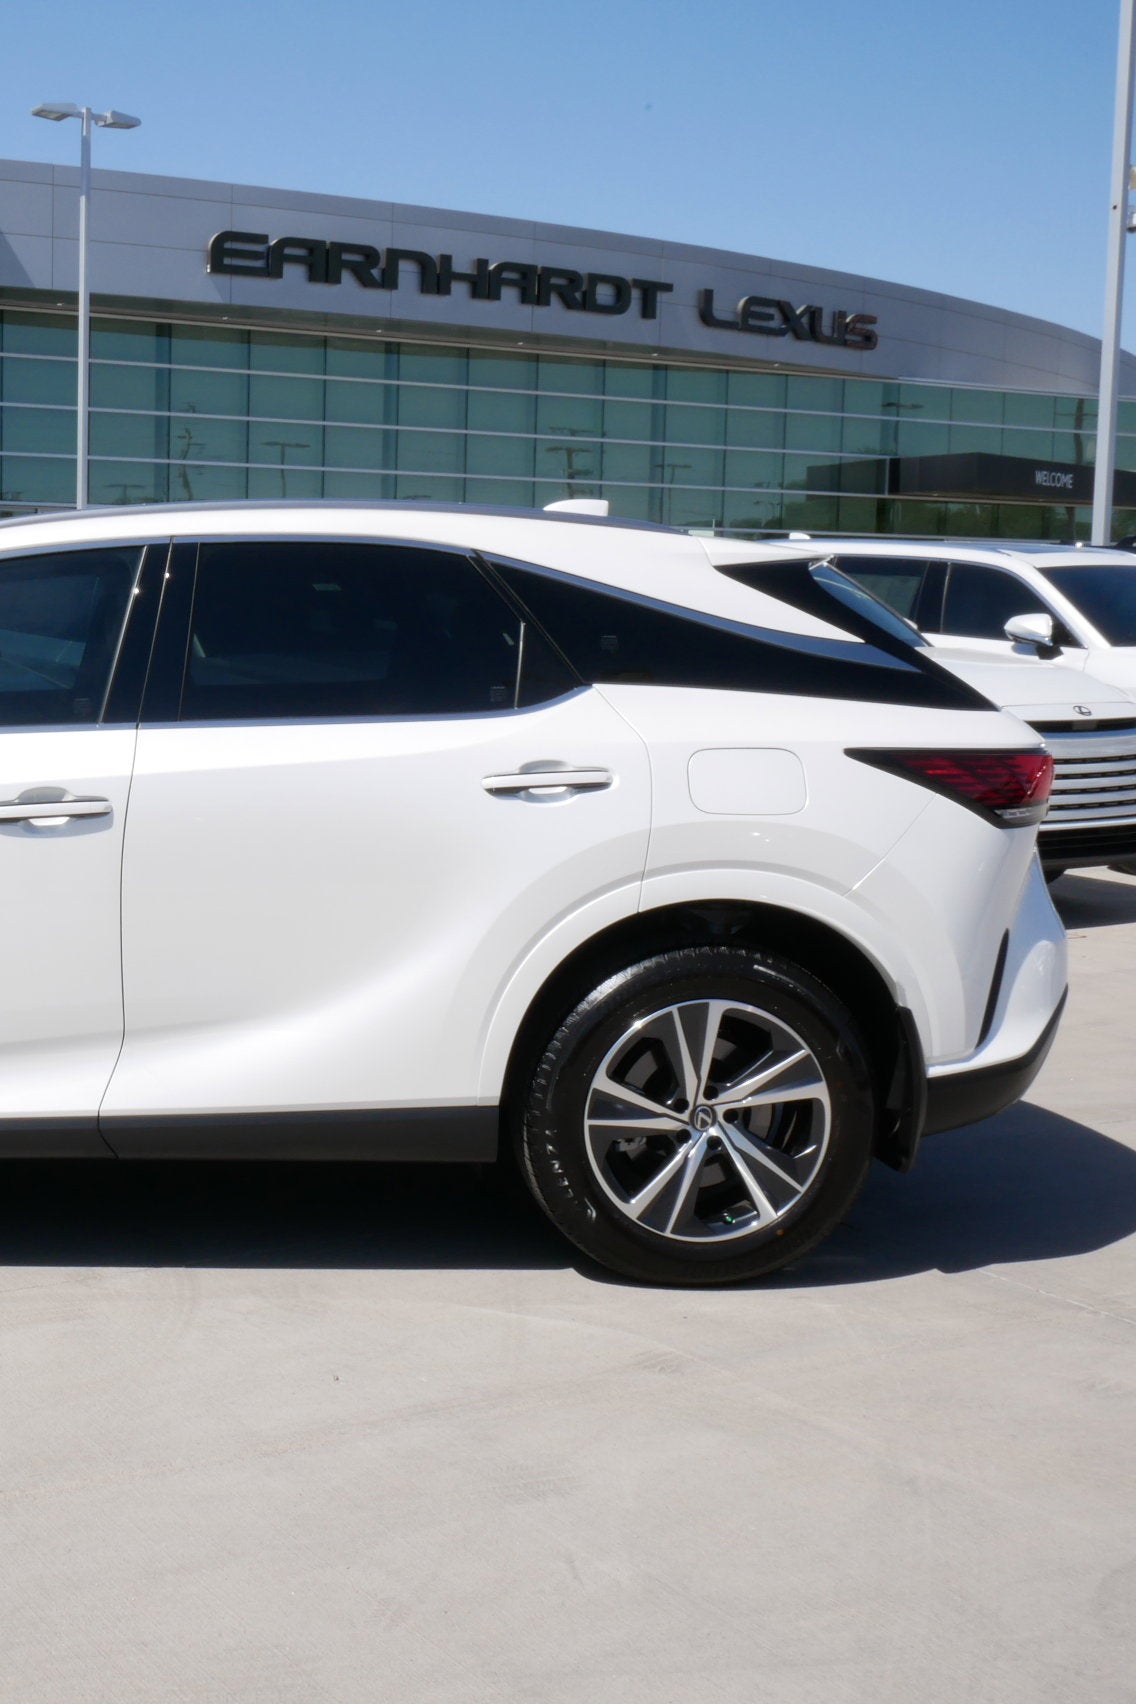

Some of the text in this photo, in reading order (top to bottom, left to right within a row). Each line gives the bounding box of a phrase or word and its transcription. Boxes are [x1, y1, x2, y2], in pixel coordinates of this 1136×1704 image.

[208, 231, 878, 350] EARNHARDT LEXUS
[1035, 470, 1074, 489] WELCOME
